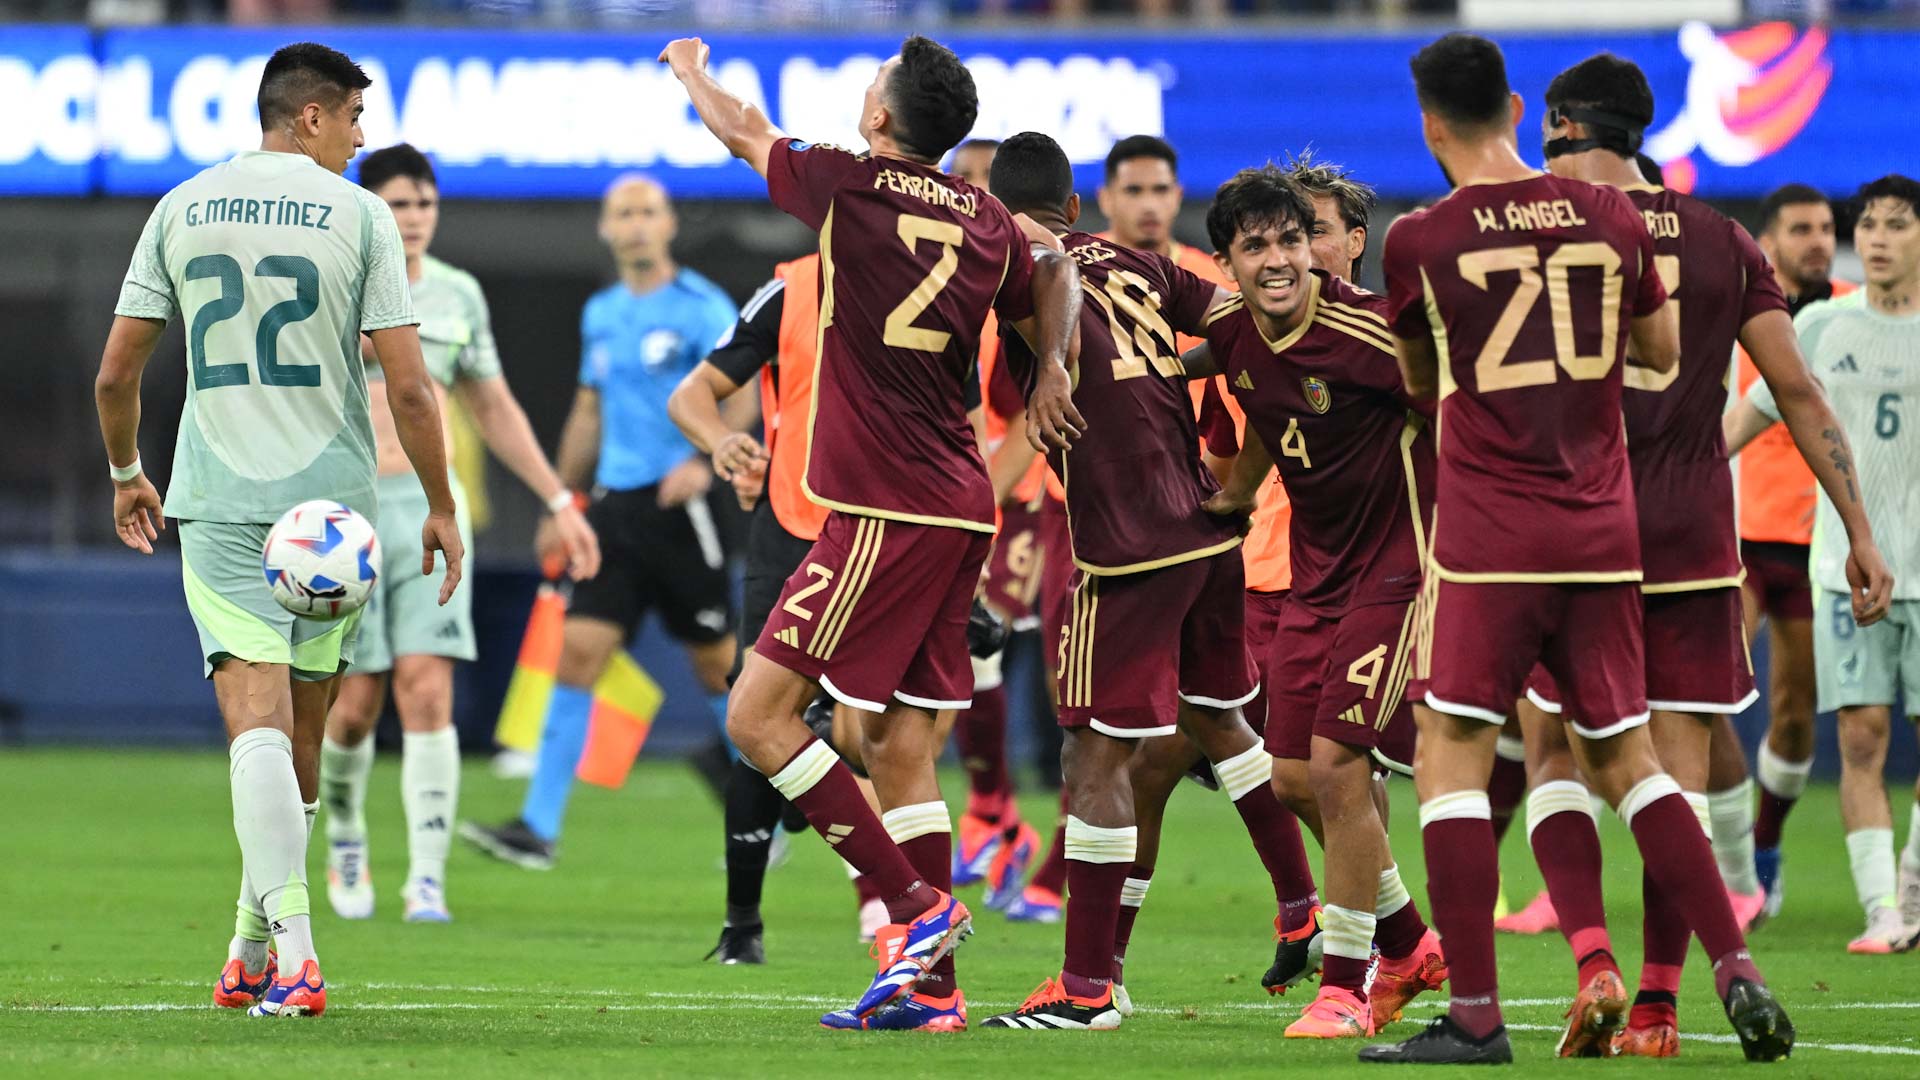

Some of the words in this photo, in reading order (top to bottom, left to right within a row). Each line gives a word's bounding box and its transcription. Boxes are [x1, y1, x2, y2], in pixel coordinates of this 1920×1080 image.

[1504, 198, 1587, 231] ÁNGEL
[883, 213, 963, 353] 2
[185, 253, 321, 391] 22
[1081, 268, 1187, 381] 18
[1457, 241, 1624, 394] 20
[1280, 417, 1313, 469] 4
[1875, 392, 1901, 441] 6
[782, 562, 834, 621] 2
[1832, 594, 1856, 641] 6
[1346, 643, 1388, 700] 4
